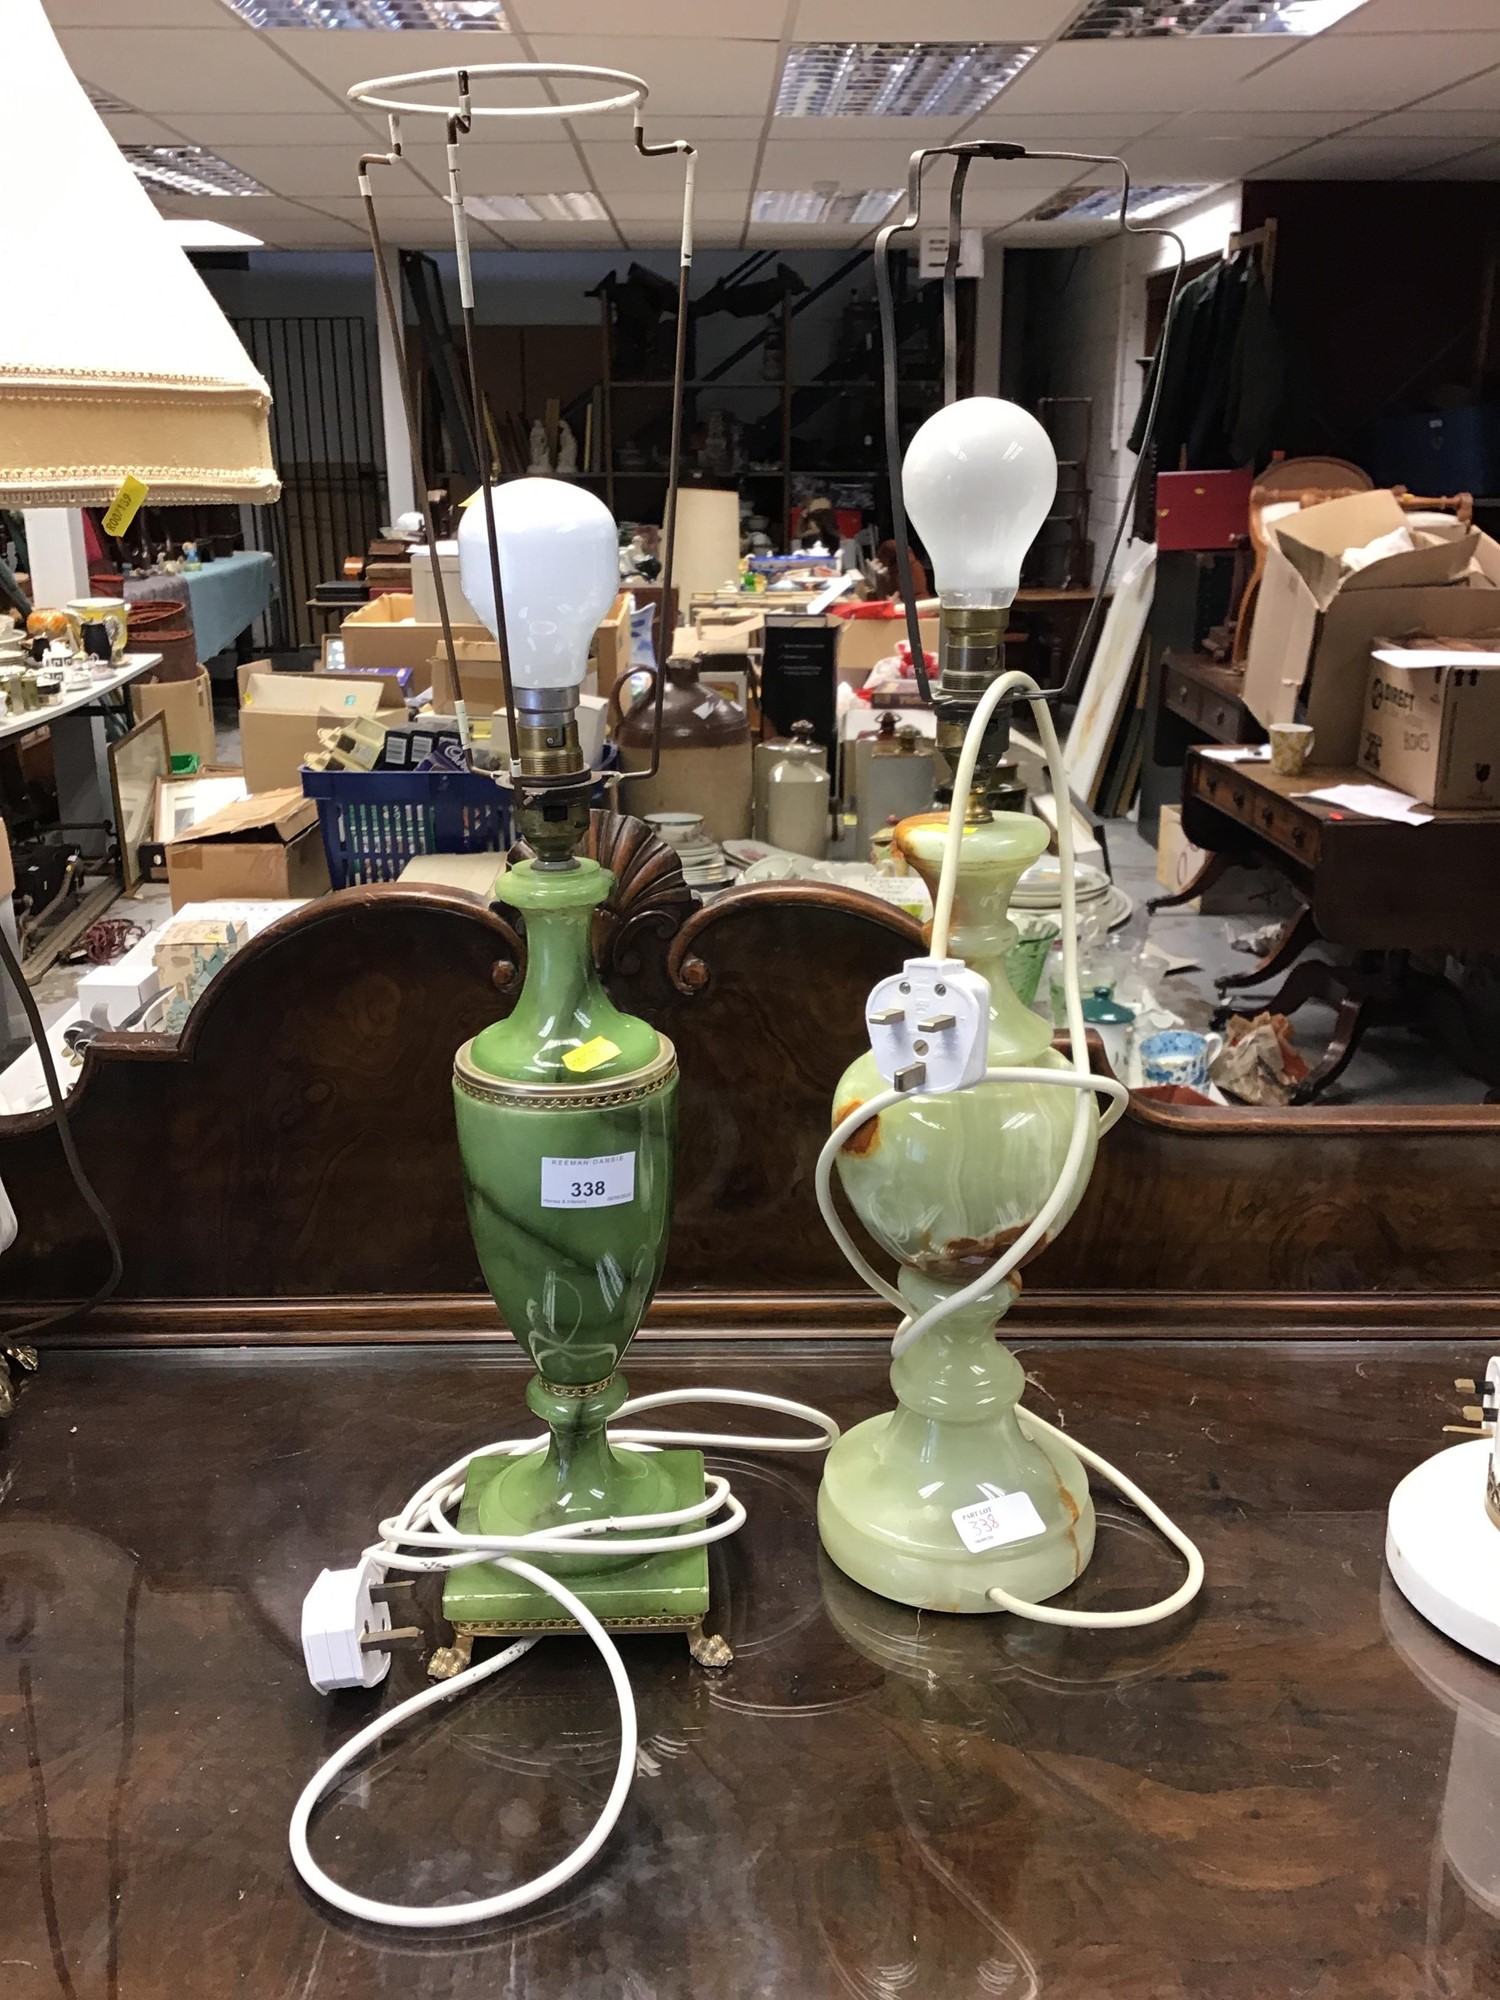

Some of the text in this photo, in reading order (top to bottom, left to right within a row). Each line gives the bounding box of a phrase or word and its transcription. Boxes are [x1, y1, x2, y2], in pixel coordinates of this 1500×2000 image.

[570, 1180, 606, 1198] 338
[962, 1506, 993, 1521] PART LOT
[967, 1513, 1000, 1536] 338
